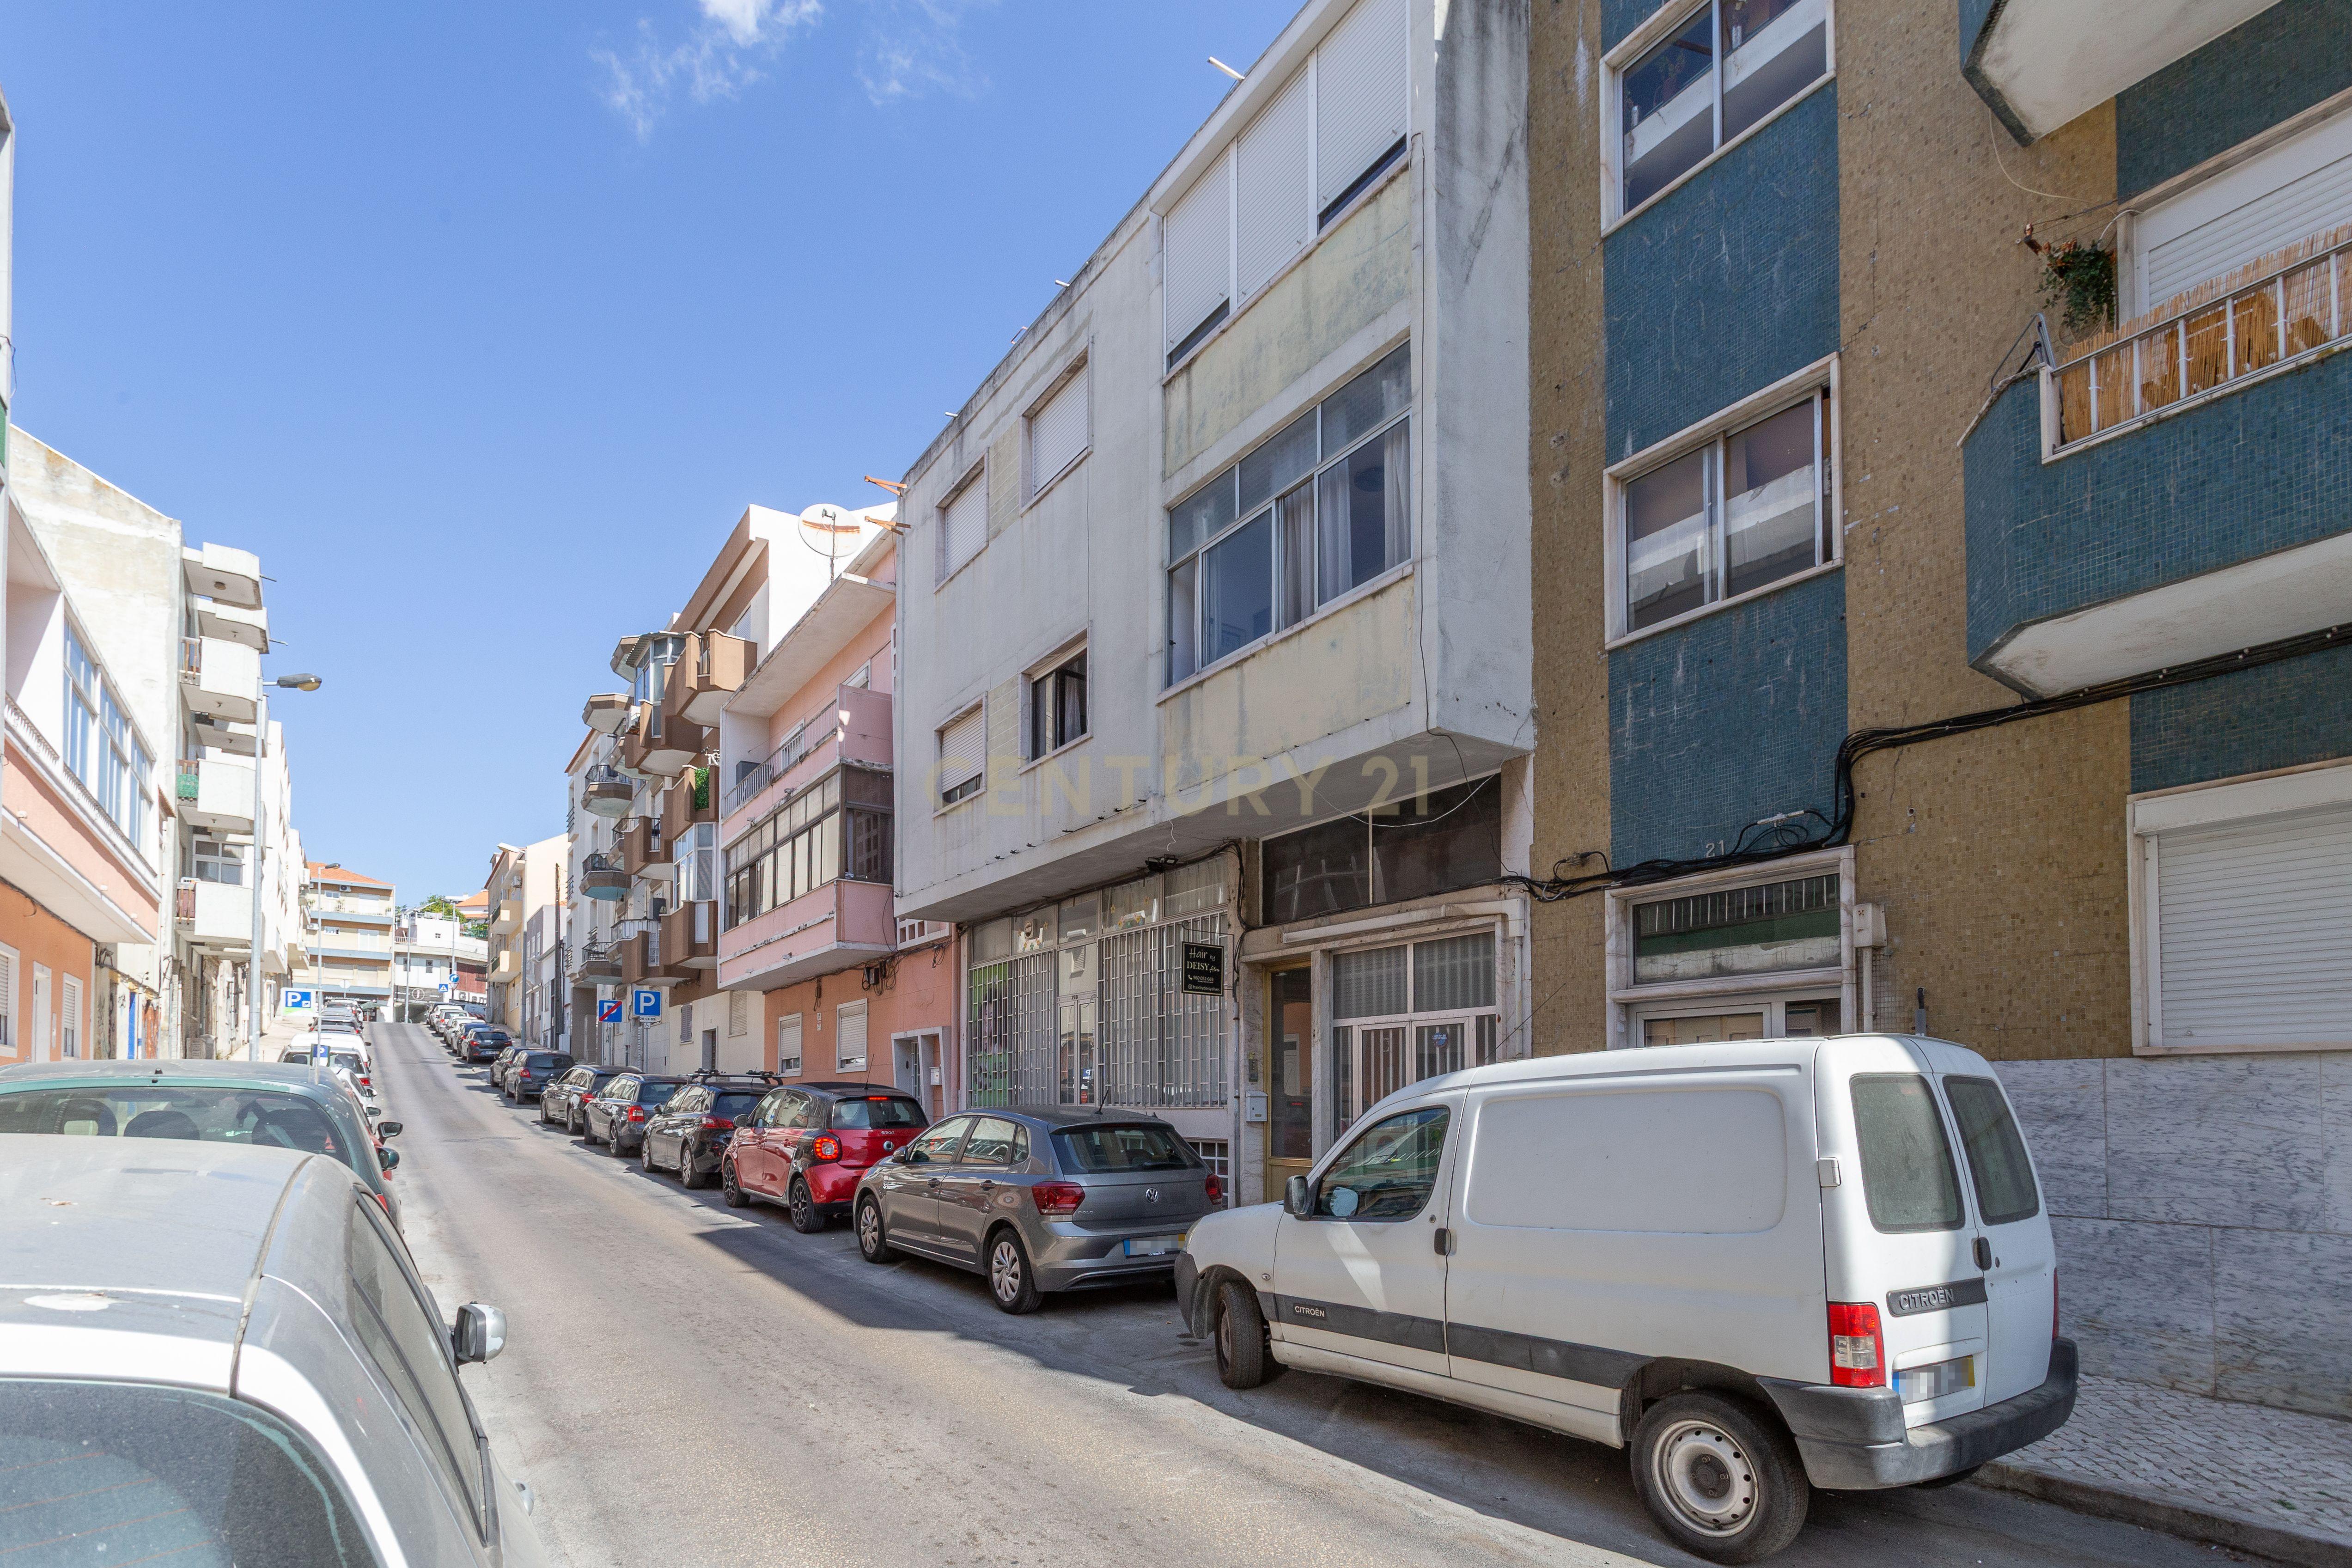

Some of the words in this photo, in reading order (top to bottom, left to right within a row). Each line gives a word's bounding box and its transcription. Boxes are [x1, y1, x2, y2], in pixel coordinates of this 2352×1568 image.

[1706, 840, 1724, 858] 21
[1189, 946, 1208, 958] Hair
[1187, 961, 1209, 970] DEISY
[287, 992, 301, 1007] P
[640, 993, 655, 1013] P
[1899, 1286, 1954, 1311] CITROËN
[1295, 1306, 1325, 1317] CITROËN
